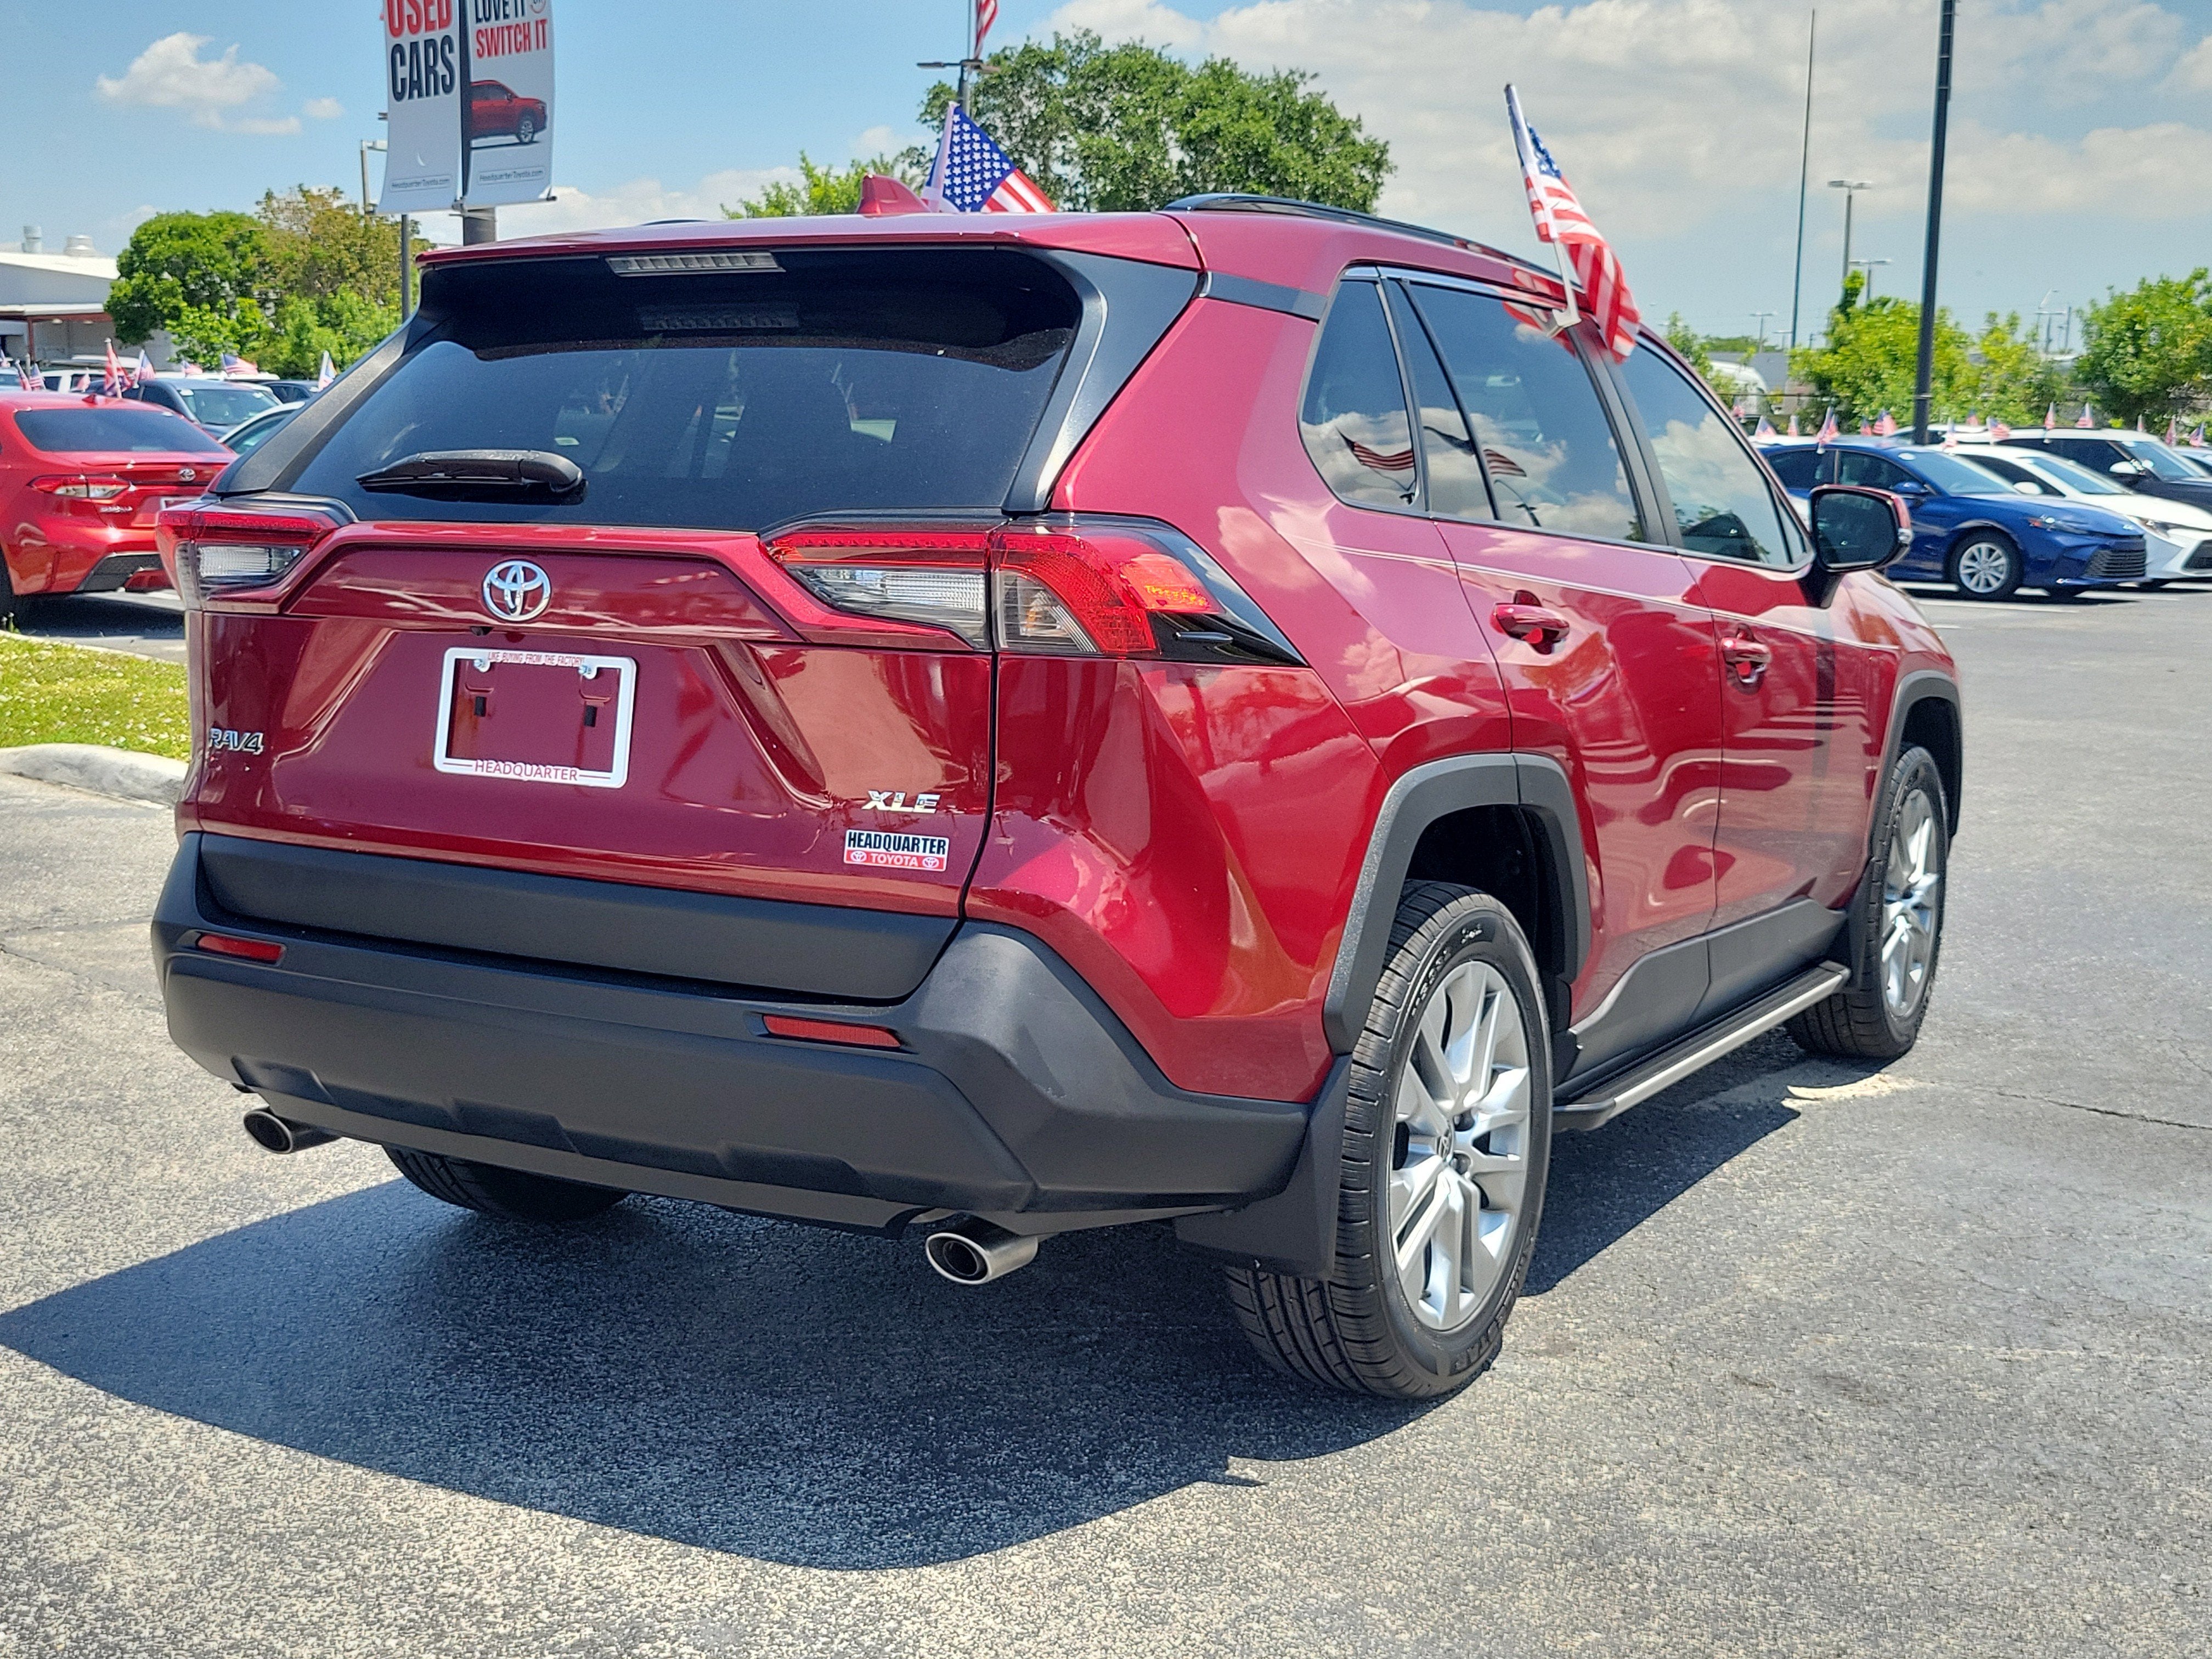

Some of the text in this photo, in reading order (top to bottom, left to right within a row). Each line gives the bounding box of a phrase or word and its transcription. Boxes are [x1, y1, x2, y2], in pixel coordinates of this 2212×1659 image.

[476, 19, 548, 59] SWITCH IT
[391, 35, 455, 102] CARS
[209, 728, 264, 755] RAV4
[475, 760, 578, 781] HEADQUARTER
[861, 790, 941, 814] XLE
[848, 831, 946, 855] HEADQUARTER
[870, 853, 919, 867] TOYOTA
